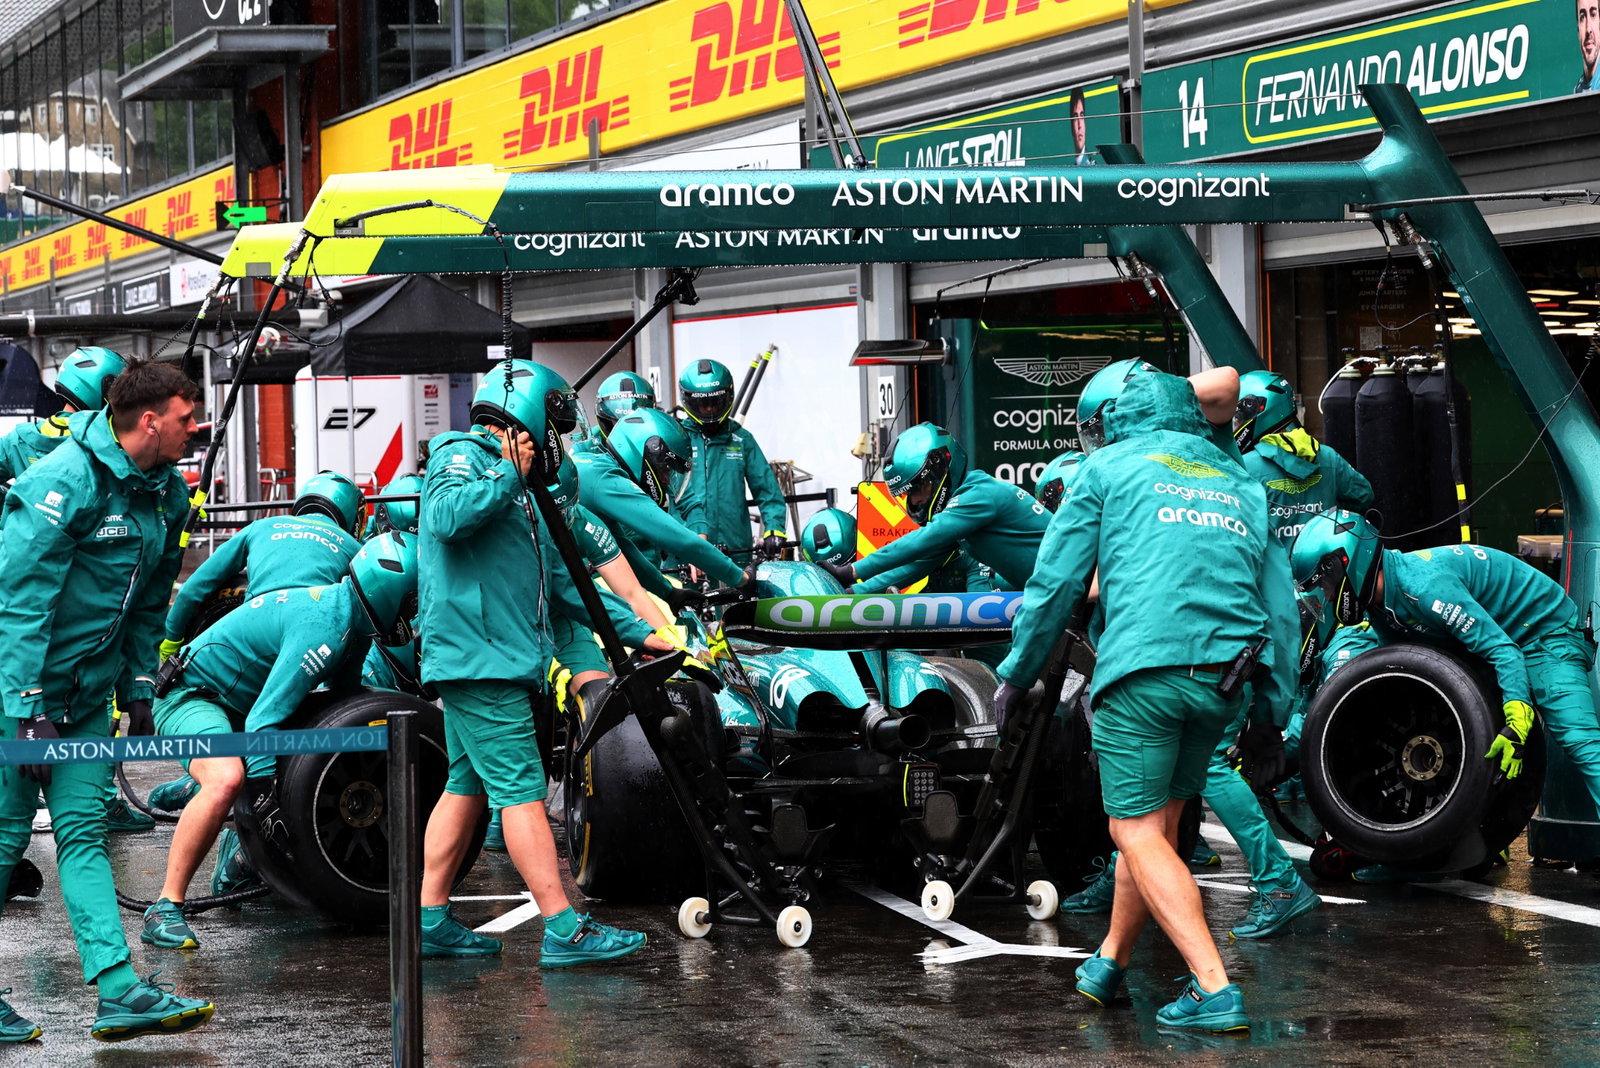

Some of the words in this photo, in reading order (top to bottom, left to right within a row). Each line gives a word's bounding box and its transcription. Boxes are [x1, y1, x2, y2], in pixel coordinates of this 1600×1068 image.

[1256, 50, 1402, 127] FERNANDO
[1406, 24, 1530, 97] ALONSO
[519, 45, 610, 156] DHL
[1178, 77, 1209, 148] 14
[388, 98, 459, 171] DHL
[962, 127, 1026, 168] STROLL
[659, 183, 795, 207] aramco
[832, 178, 944, 207] ASTON
[955, 175, 1083, 205] MARTIN
[1117, 172, 1270, 207] cognizant
[514, 232, 646, 256] cognizant
[675, 230, 768, 249] ASTON
[777, 229, 884, 246] MARTN
[1052, 362, 1079, 370] MARTIN
[879, 382, 894, 416] 30
[993, 403, 1077, 434] cogniz
[547, 429, 561, 468] cognizant
[993, 440, 1051, 451] FORMULA
[1053, 438, 1079, 449] ONE
[994, 462, 1048, 485] ara
[1154, 482, 1241, 510] cognizant
[1269, 500, 1323, 519] cognizant
[98, 527, 128, 537] JCB
[272, 522, 345, 547] cognizant
[1158, 507, 1247, 537] aramco
[270, 532, 340, 553] aramco
[1461, 617, 1476, 634] BOSS
[1300, 638, 1316, 674] cognizant
[44, 741, 115, 760] ASTON
[125, 738, 211, 758] MARTIN
